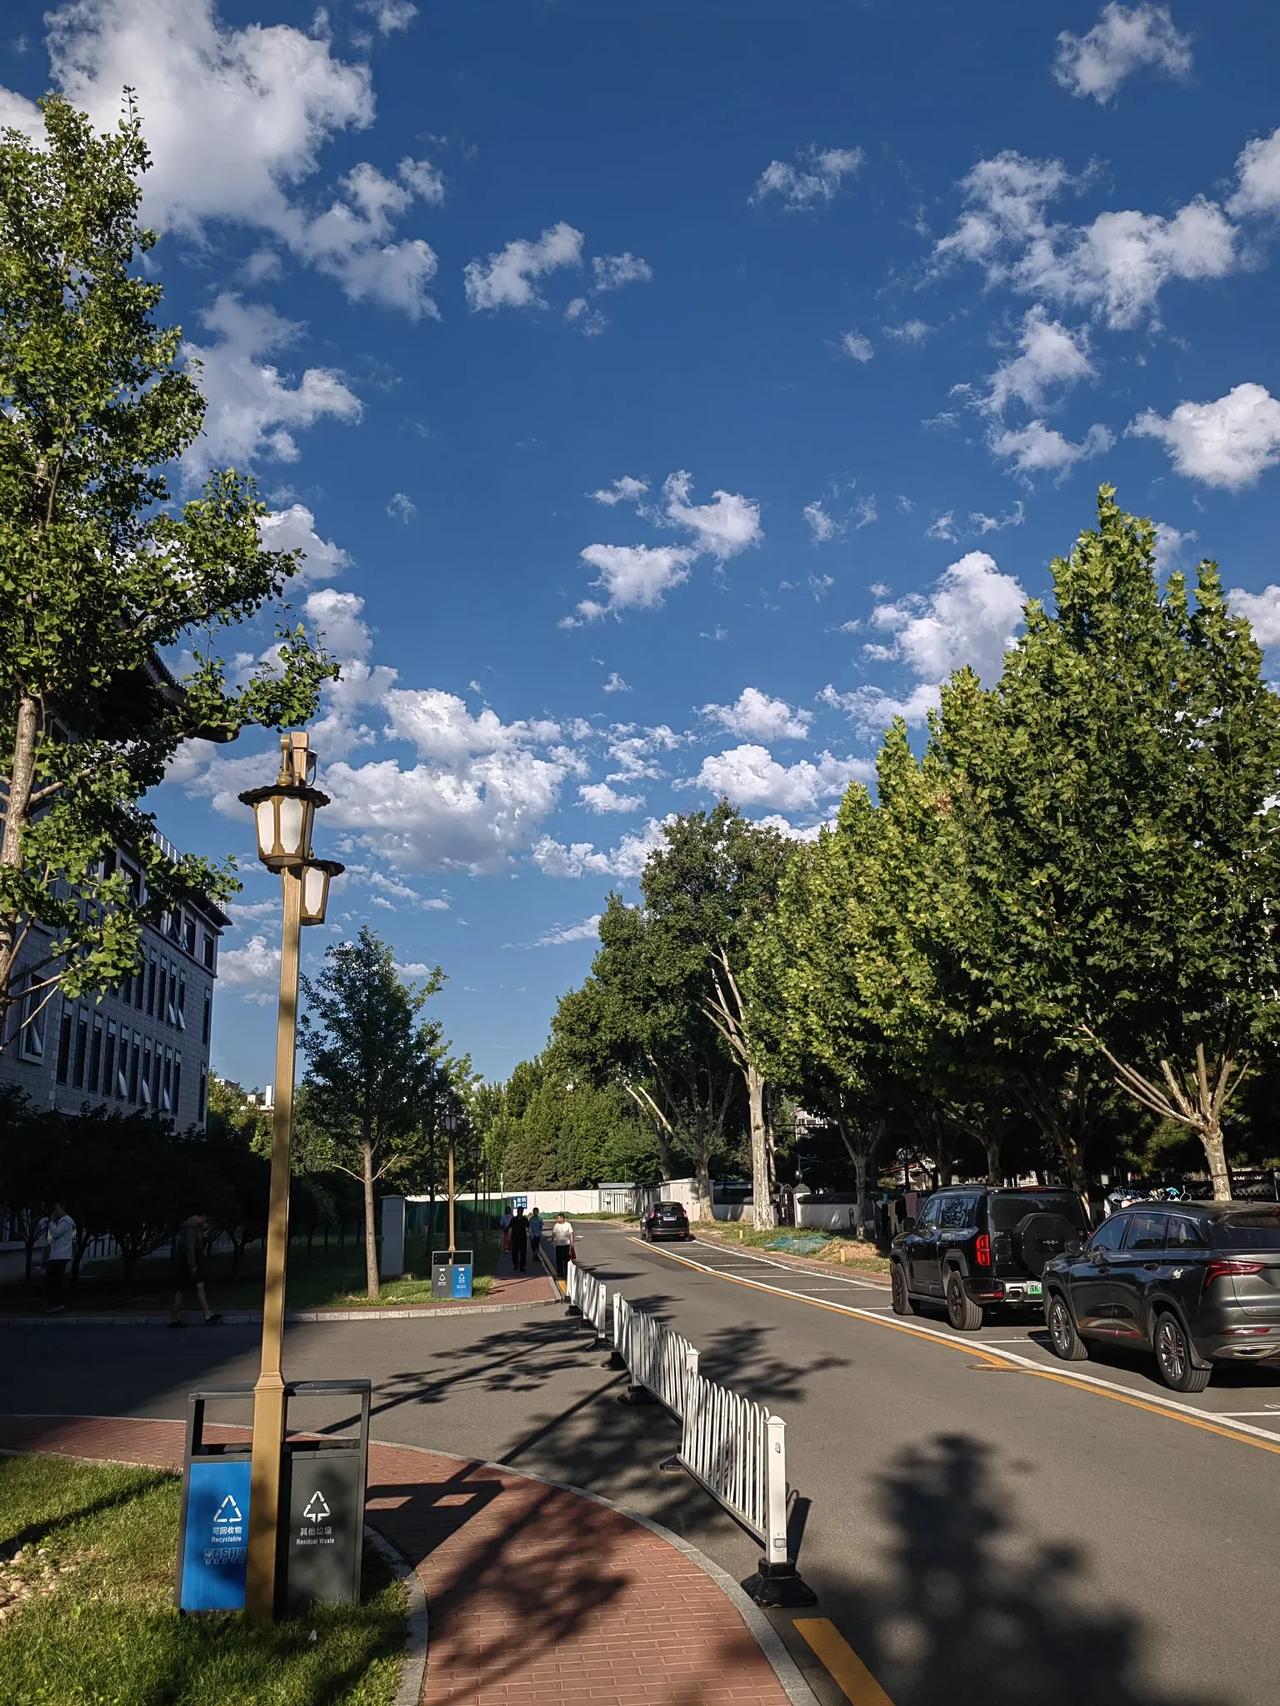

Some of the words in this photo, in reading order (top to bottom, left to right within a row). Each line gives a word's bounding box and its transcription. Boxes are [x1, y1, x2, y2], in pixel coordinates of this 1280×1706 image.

[212, 1526, 242, 1535] 可回收物
[300, 1526, 332, 1536] 其他垃圾
[210, 1535, 242, 1544] Recyclable
